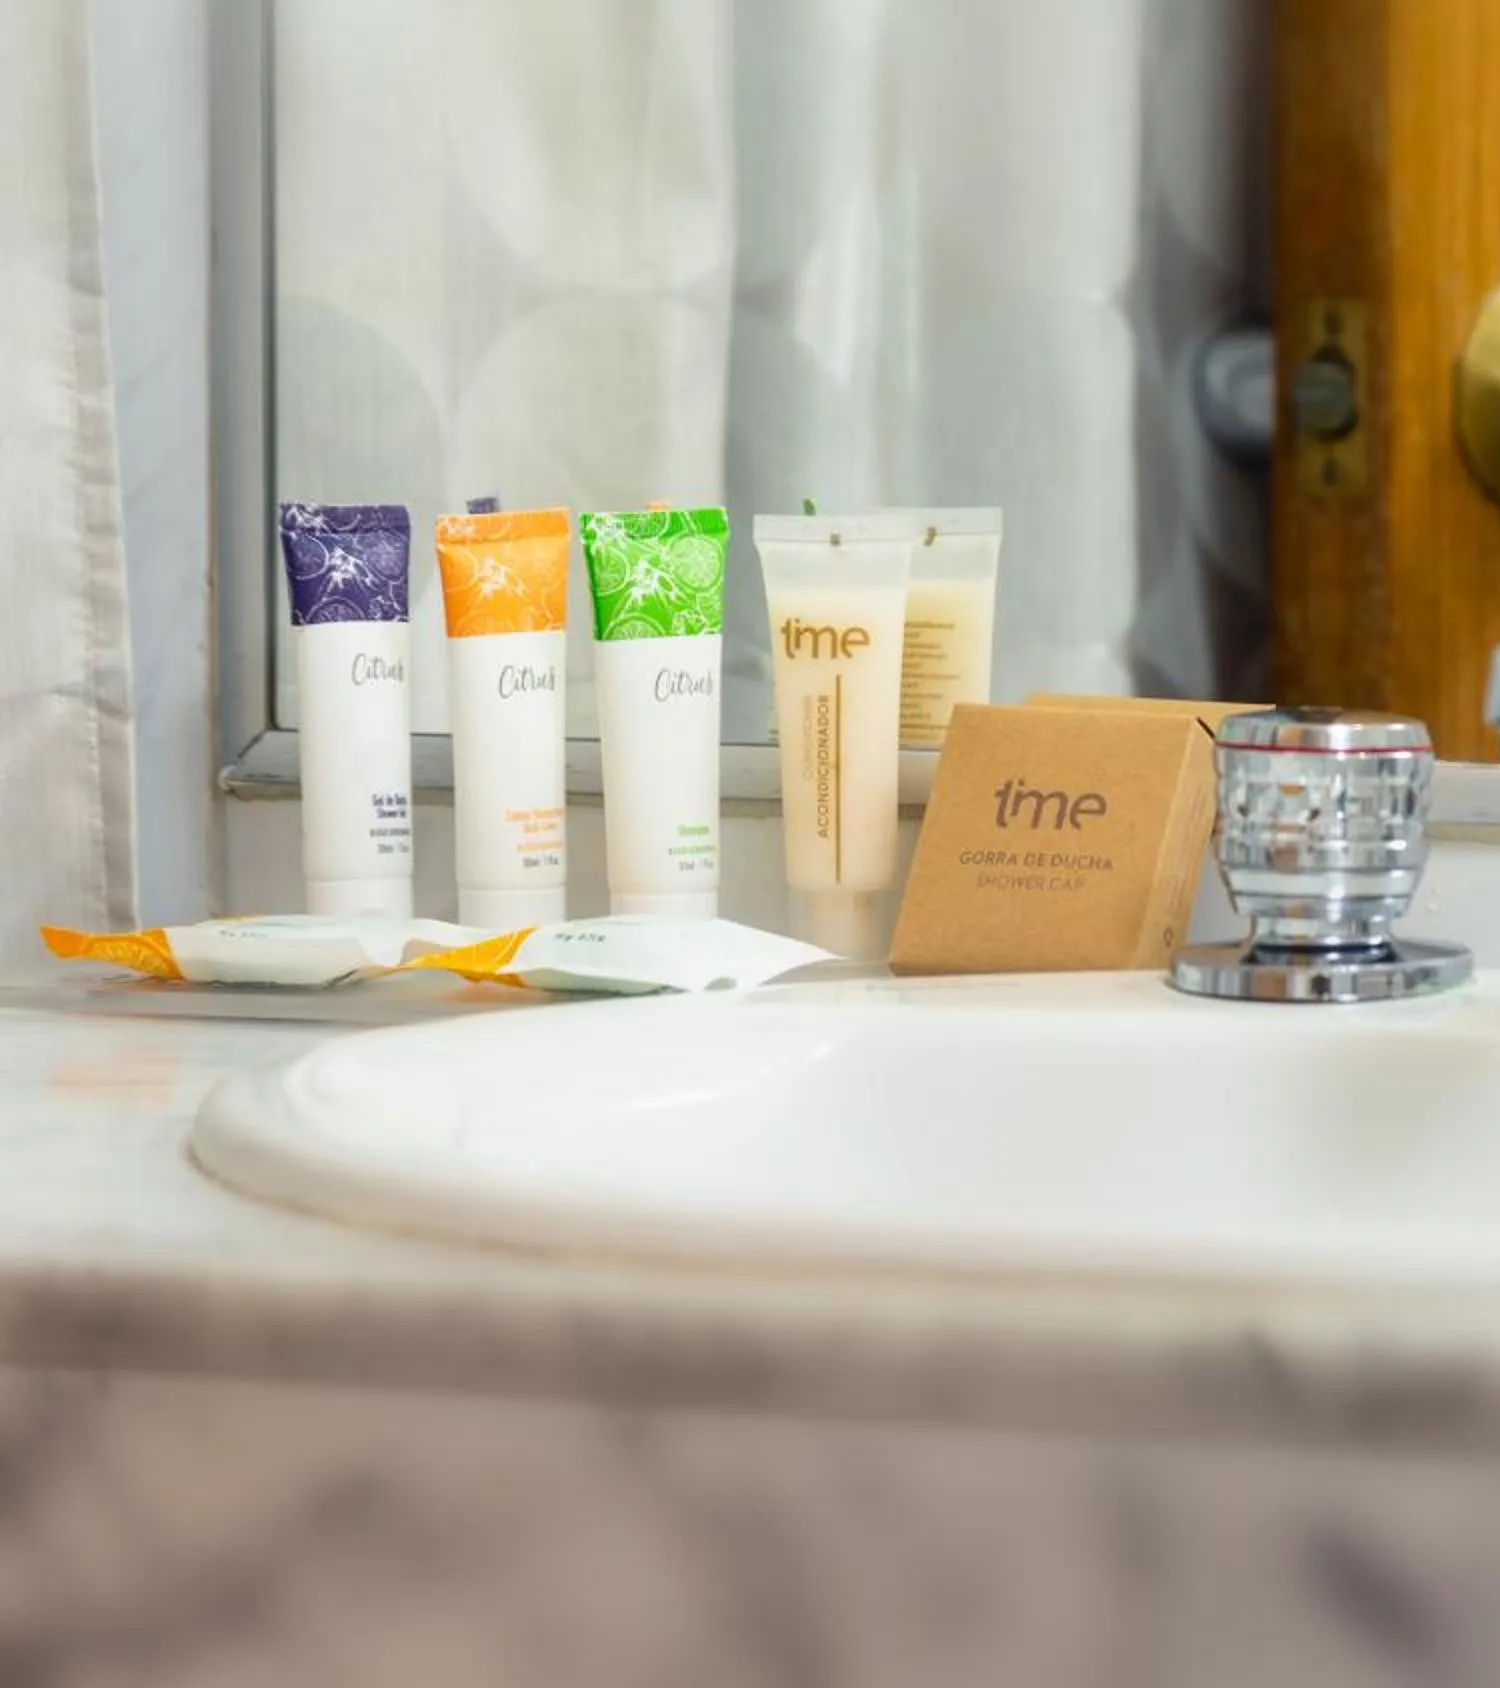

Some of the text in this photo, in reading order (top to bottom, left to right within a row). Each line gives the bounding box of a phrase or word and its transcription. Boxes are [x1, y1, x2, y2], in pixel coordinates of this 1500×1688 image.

[781, 618, 871, 659] time
[351, 652, 405, 686] Citrus
[499, 664, 556, 699] Citrus
[655, 667, 714, 702] Citrus
[817, 695, 830, 839] ACONDICIONADOR
[995, 778, 1107, 830] time
[959, 850, 1114, 871] GORRA DE DUCHA
[976, 872, 1046, 891] SHOWER
